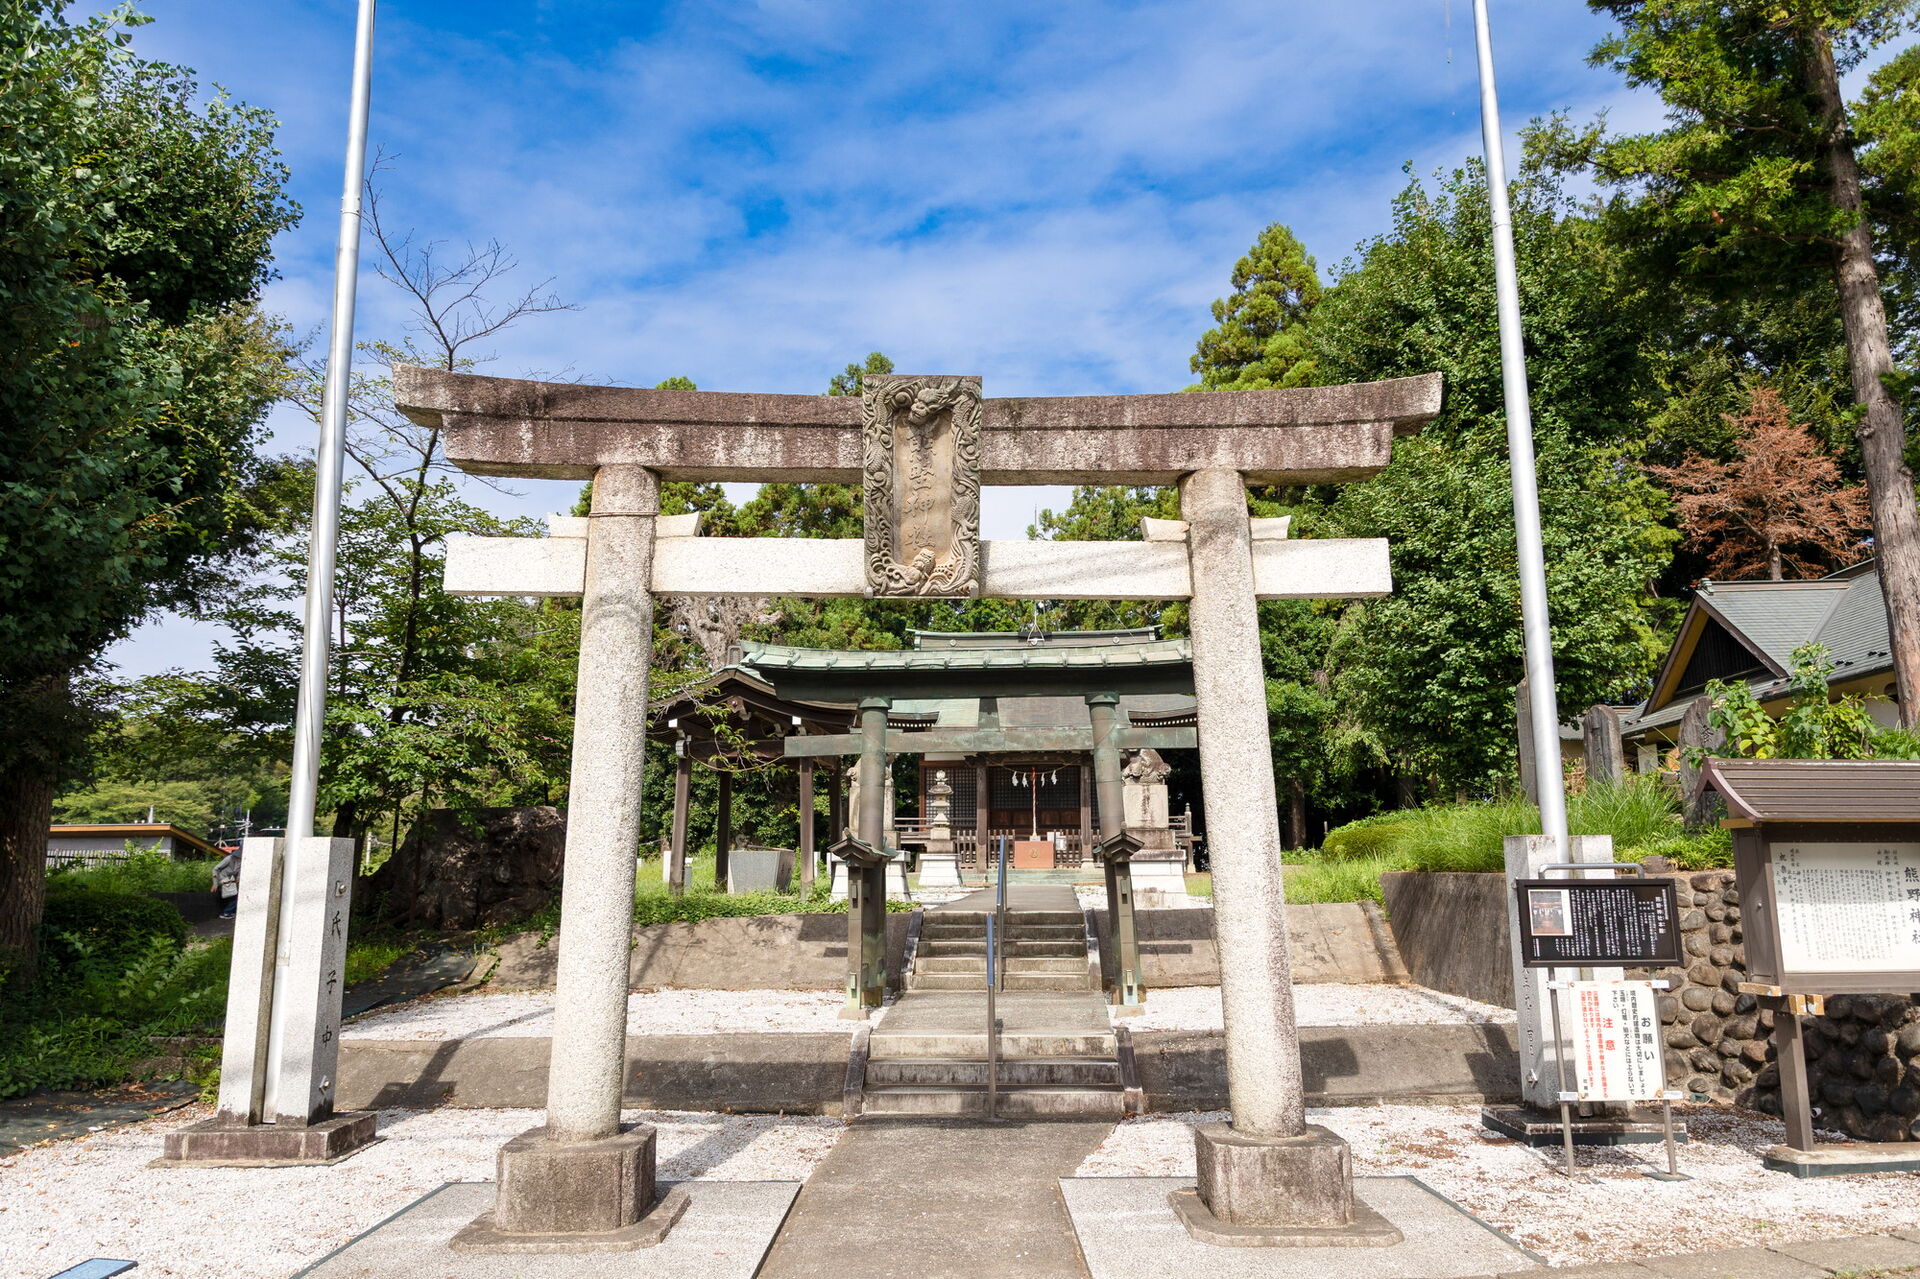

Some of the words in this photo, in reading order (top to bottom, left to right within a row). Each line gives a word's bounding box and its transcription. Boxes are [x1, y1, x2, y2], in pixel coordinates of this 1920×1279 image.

[322, 911, 341, 1048] 氏子中
[1602, 1017, 1616, 1051] 注意
[1641, 1017, 1655, 1061] お願い
